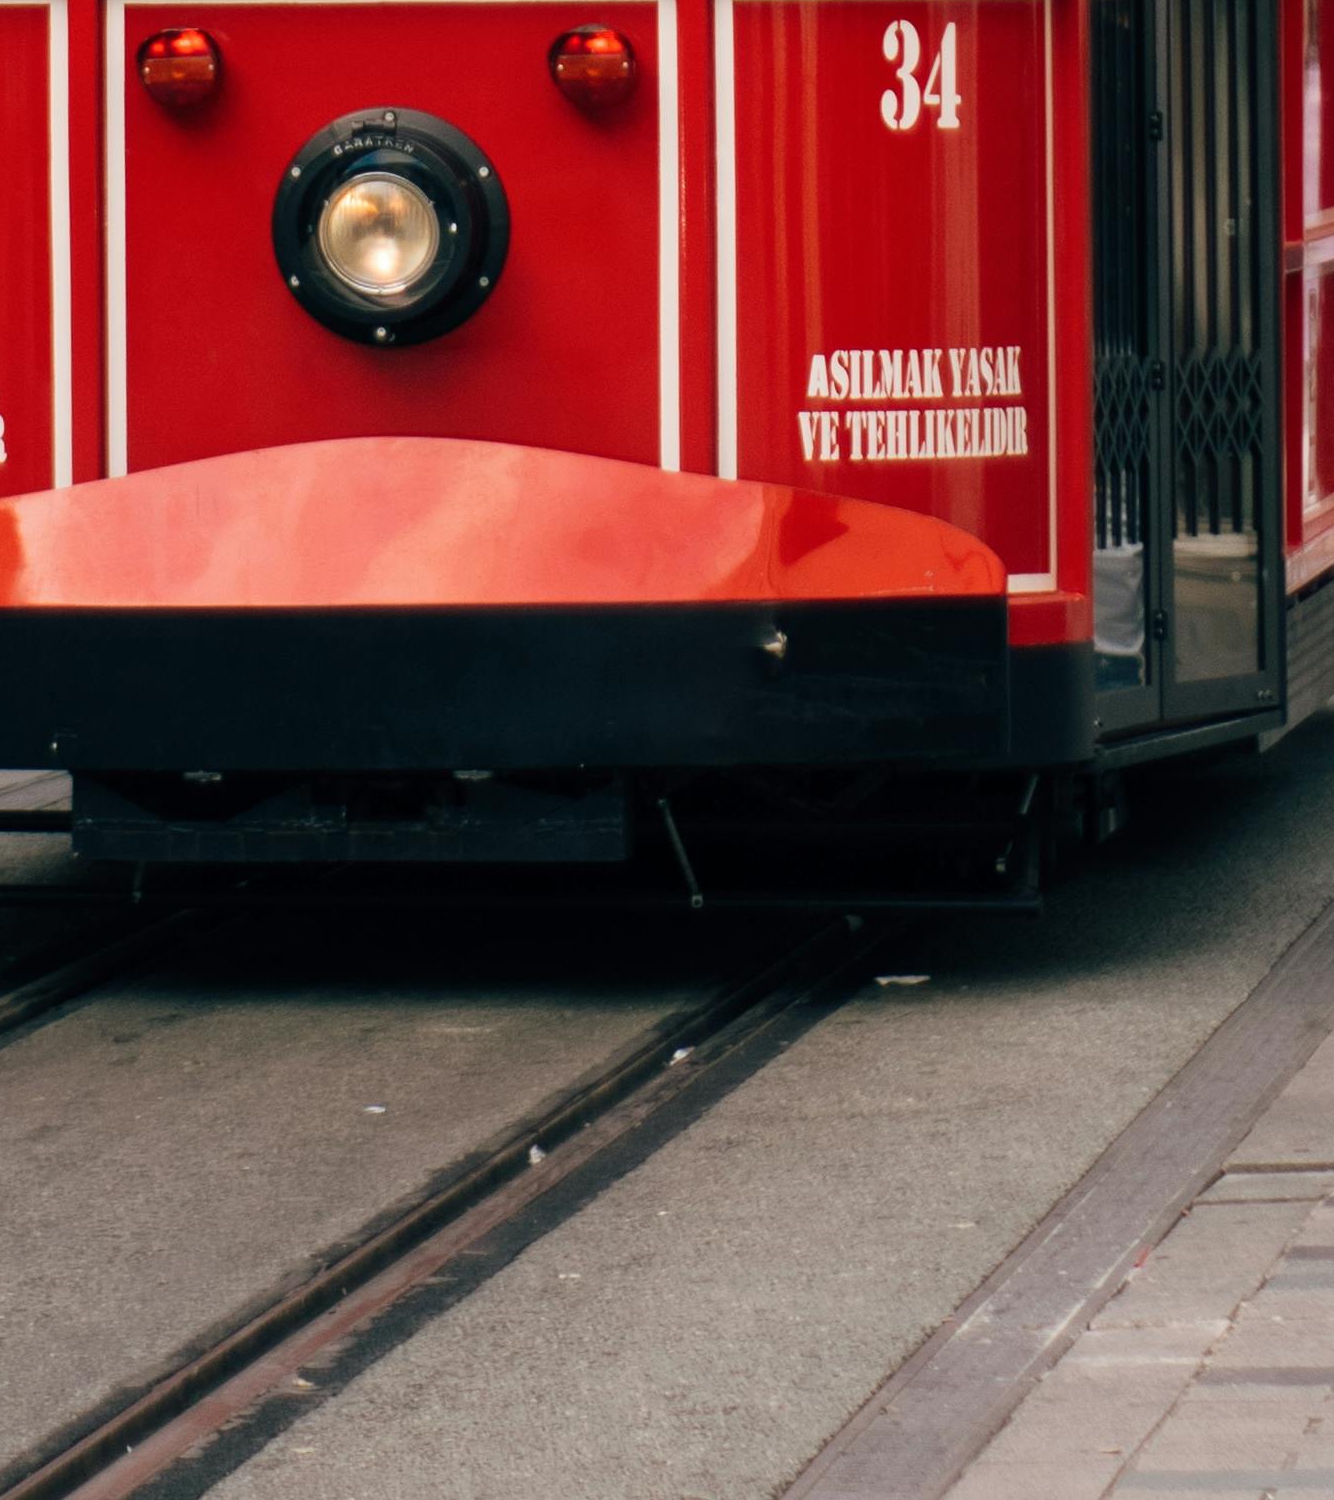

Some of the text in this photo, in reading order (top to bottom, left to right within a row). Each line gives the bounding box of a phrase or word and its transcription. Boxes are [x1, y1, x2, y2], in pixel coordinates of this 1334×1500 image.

[881, 19, 962, 130] 34
[807, 346, 1021, 400] ASILMAK YASAK
[798, 406, 1028, 461] VE TEHLIKELIDIR
